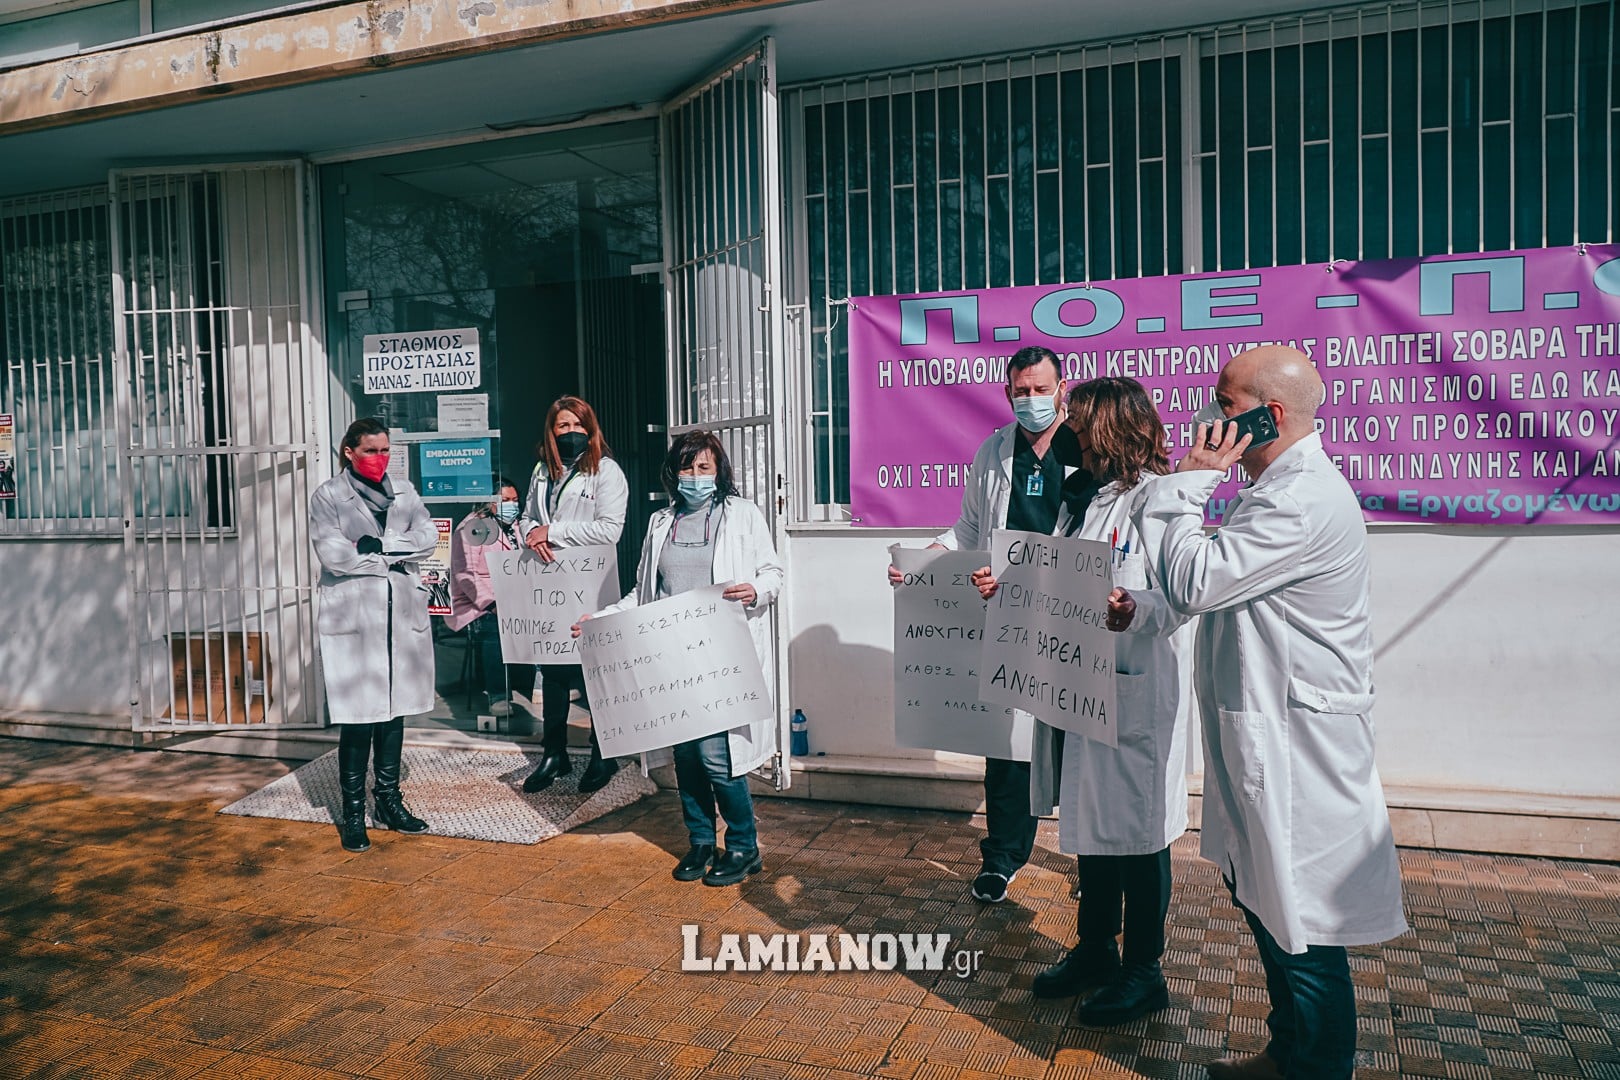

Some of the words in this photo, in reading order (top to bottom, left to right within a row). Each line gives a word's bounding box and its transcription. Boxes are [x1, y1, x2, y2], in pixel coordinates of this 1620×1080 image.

[379, 335, 463, 353] ΣΤΑΘΜΟΣ
[368, 352, 475, 371] ΠΡΟΣΤΑΣΙΑΣ
[878, 360, 893, 388] Η
[898, 355, 1010, 387] ΥΠΟΒΑΘΜ
[1105, 344, 1220, 379] ΚΕΝΤΡΩΝ
[1325, 331, 1442, 368] ΒΛΑΠΤΕΙ
[1451, 326, 1567, 363] ΣΟΒΑΡΑ
[1575, 322, 1620, 357] ΤΗ
[368, 374, 412, 390] ΜΑΝΑΣ
[423, 371, 476, 387] ΠΑΙΔΙΟΥ
[1510, 371, 1569, 399] ΕΔΩ
[1412, 408, 1619, 442] ΠΡΟΣΩΠΙΚΟΥ
[425, 448, 486, 458] ΕΜΒΟΛΙΑΣΤΙΚΟ
[440, 457, 473, 466] ΚΕΝΤΡΟ
[878, 464, 912, 488] ΟΧΙ
[1532, 450, 1580, 478] ΚΑΙ
[502, 557, 606, 576] ΕΝΙΣΧΥΣΗ
[903, 572, 935, 587] ΟΧΙ
[934, 598, 960, 609] ΤΟΥ
[997, 582, 1034, 609] ΤΩΝ
[501, 618, 556, 635] ΜΟΝΙΜΕΣ
[582, 629, 623, 651] ΑΜΕΣΗ
[637, 602, 717, 635] ΣΥΣΤΑΣΗ
[905, 623, 984, 641] ΑΝΘΥΓΙΕΙ
[533, 640, 580, 655] ΠΡΟΣΛ
[996, 624, 1029, 648] ΣΤΑ
[1037, 630, 1082, 668] ΒΑΡΕΑ
[1092, 653, 1113, 679] ΚΑΙ
[587, 652, 664, 681] ΟΡΓΑΝΙΣΜΟΥ
[686, 637, 713, 651] ΚΑΙ
[594, 665, 742, 711] ΟΡΓΑΝΟΓΡΑΜΜΑΤΟΣ
[990, 663, 1107, 726] ΑΝΘΥΓΙΕΙΝΑ
[602, 726, 625, 741] ΣΤΑ
[633, 708, 691, 733] ΚΕΝΤΡΑ
[702, 690, 760, 713] ΥΓΕΙΑΣ
[944, 700, 990, 712] ΑΛΛΕΣ
